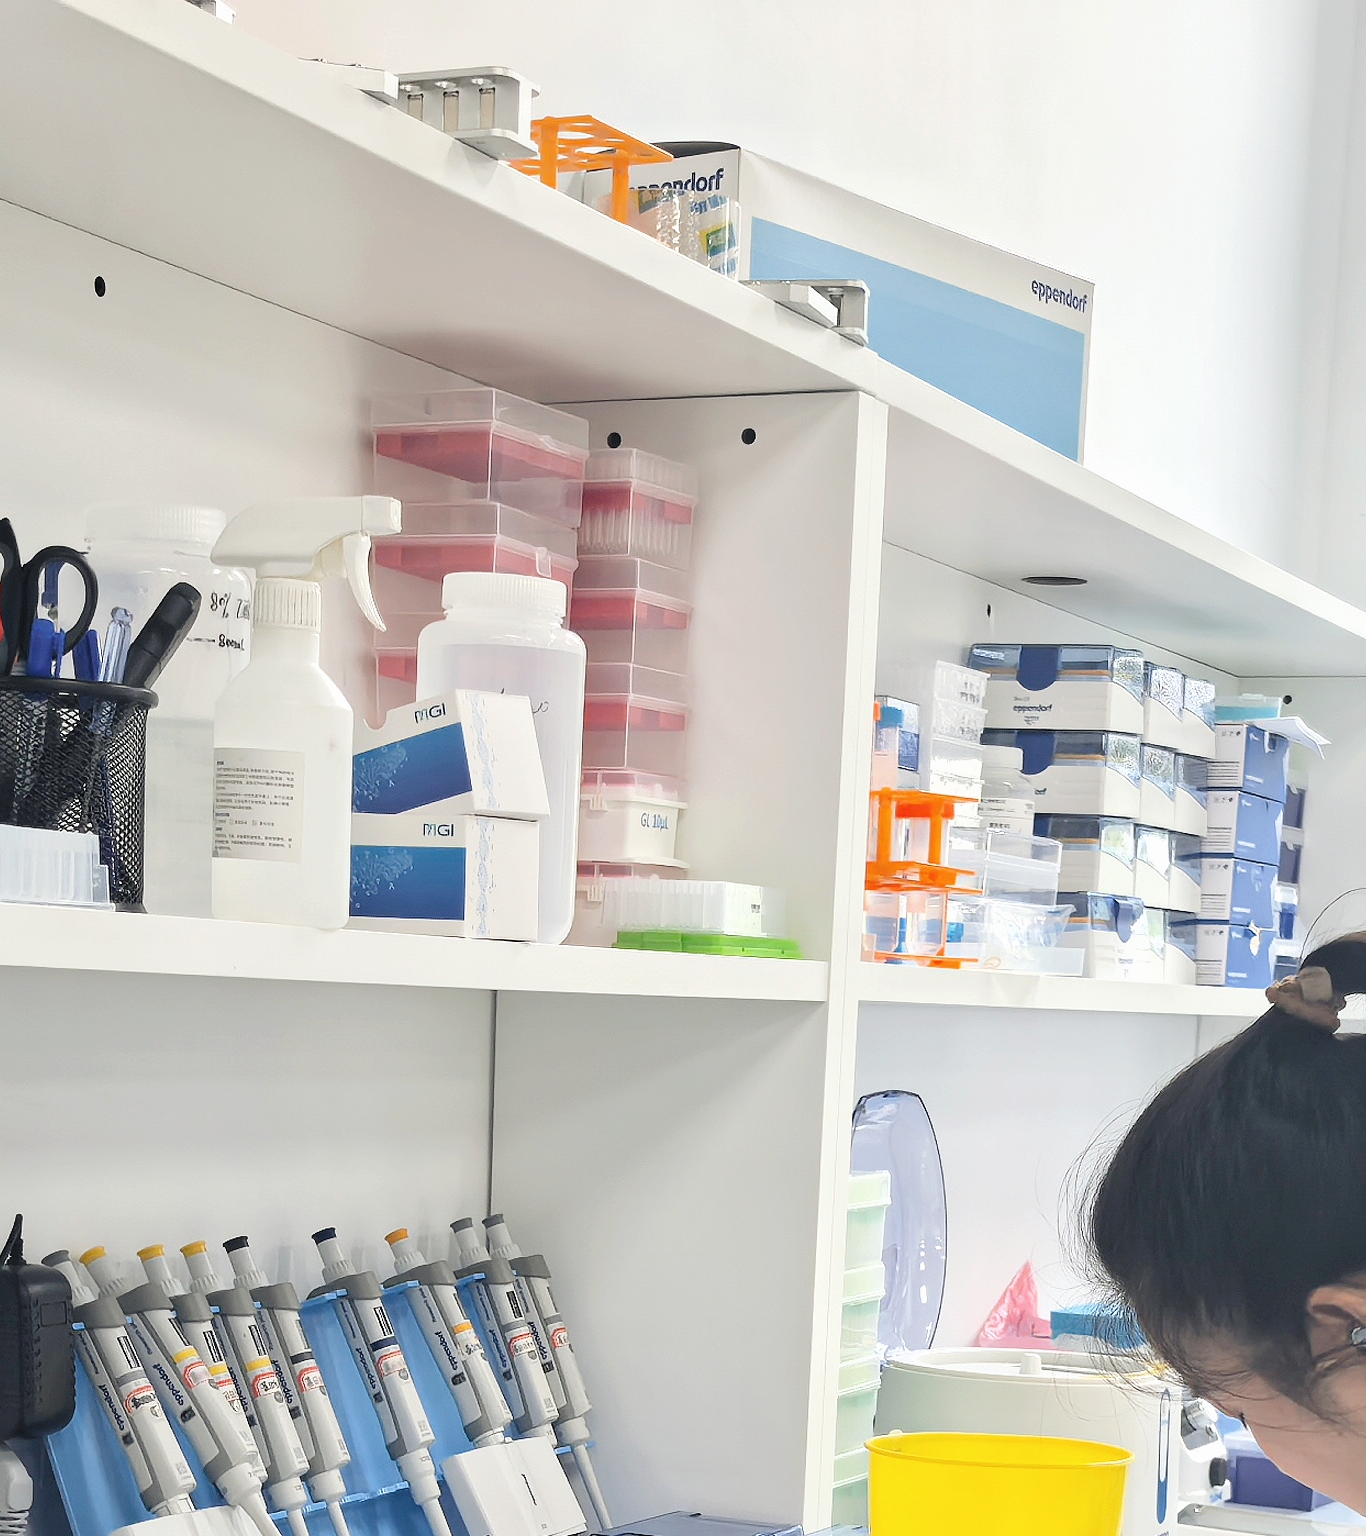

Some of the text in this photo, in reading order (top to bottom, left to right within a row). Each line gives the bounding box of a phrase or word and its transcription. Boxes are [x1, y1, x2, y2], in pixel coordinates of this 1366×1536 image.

[1032, 280, 1087, 313] eppendorf
[415, 703, 446, 724] MGI
[1013, 703, 1053, 714] eppendorf
[423, 823, 454, 837] MGI
[435, 1330, 458, 1371] eppendorf
[152, 1363, 185, 1406] eppendorf
[271, 1359, 294, 1404] eppendorf
[78, 1384, 126, 1431] eppendorf
